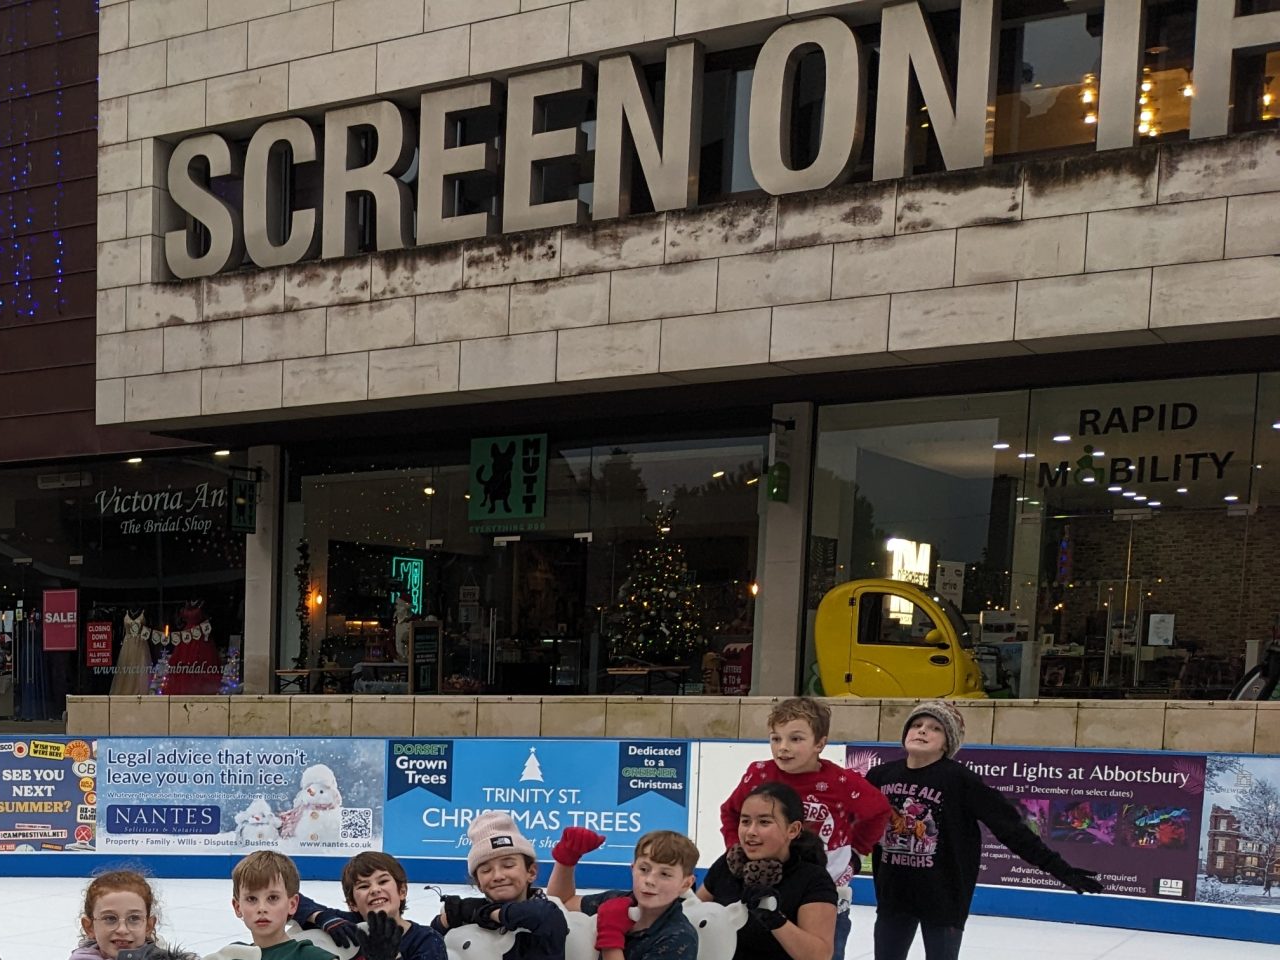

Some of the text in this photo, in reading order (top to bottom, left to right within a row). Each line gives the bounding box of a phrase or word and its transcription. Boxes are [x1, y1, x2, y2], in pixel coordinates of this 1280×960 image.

[164, 42, 704, 280] SCREEN
[749, 0, 996, 196] ON
[1078, 402, 1199, 436] RAPID
[522, 438, 541, 514] MUTT
[95, 485, 183, 515] Victoria
[186, 482, 227, 513] An
[120, 515, 212, 535] The Bridal Shop
[45, 612, 77, 624] SALE!
[728, 675, 736, 685] TO
[394, 744, 448, 755] DORSET
[628, 746, 681, 756] Dedicated
[107, 748, 151, 767] Legal
[156, 748, 212, 765] advice
[217, 749, 252, 765] that
[256, 749, 307, 765] won't
[396, 756, 447, 770] Grown
[644, 757, 664, 767] to a
[2, 769, 65, 781] SEE YOU
[107, 768, 288, 787] leave you on thin ice.
[405, 770, 447, 785] Trees
[622, 767, 677, 779] GREENER
[966, 760, 1190, 788] inter Lights at Abbotsbury
[12, 785, 55, 797] NEXT
[629, 779, 683, 790] Christmas
[1031, 785, 1069, 795] December
[1071, 788, 1084, 796] (on
[1085, 788, 1107, 796] select
[1109, 789, 1133, 798] dates)
[483, 787, 581, 805] TRINITY ST.
[918, 786, 942, 804] ALL
[115, 807, 213, 824] NANTES
[568, 811, 641, 832] TREES
[3, 831, 64, 839] CAMPBESTIVAL.NET
[105, 838, 138, 846] Property
[146, 838, 170, 846] Family
[204, 838, 237, 846] Disputes
[891, 853, 935, 868] NEIGHS
[1103, 874, 1137, 882] required
